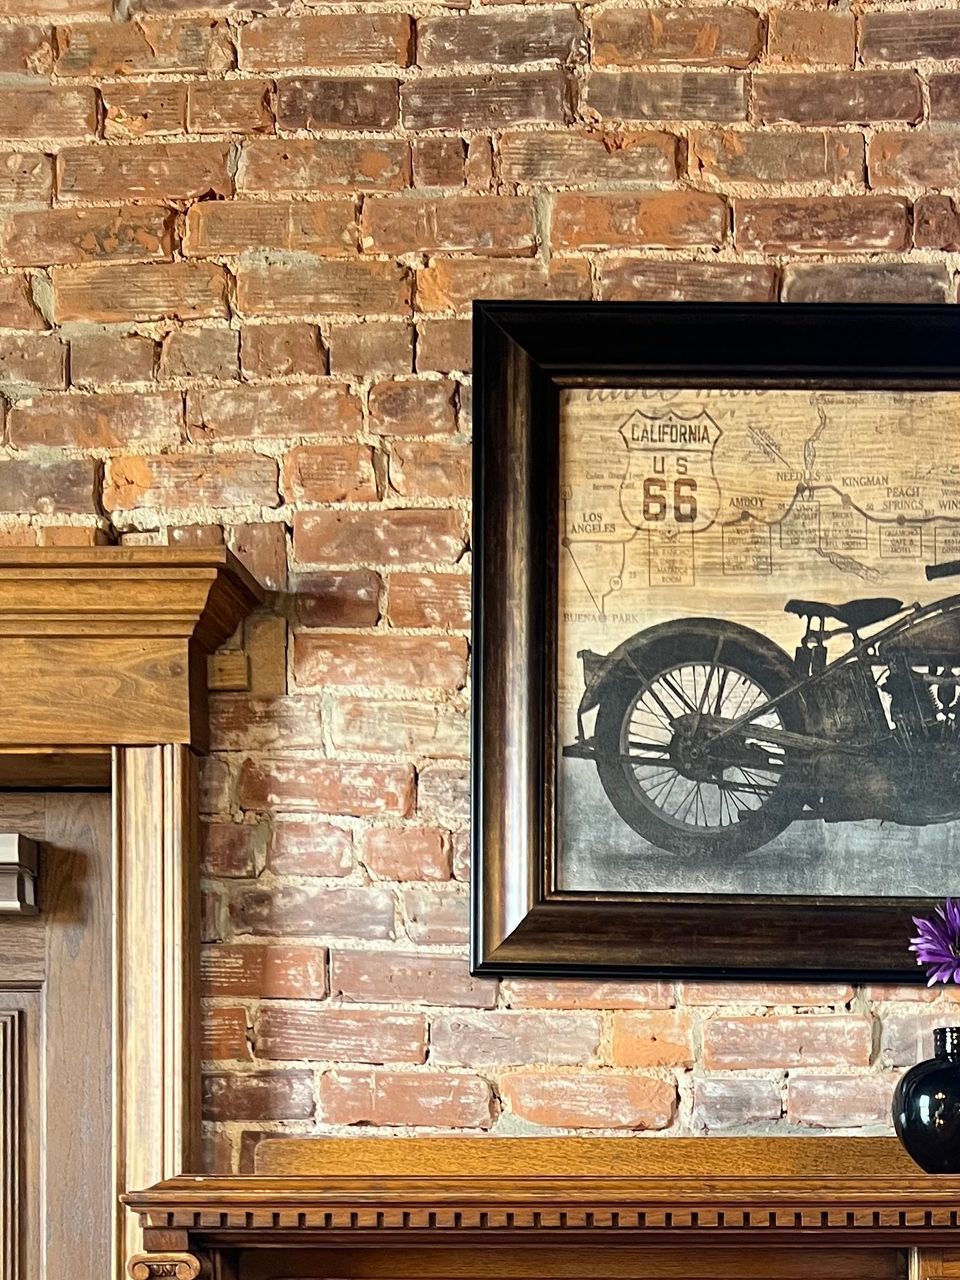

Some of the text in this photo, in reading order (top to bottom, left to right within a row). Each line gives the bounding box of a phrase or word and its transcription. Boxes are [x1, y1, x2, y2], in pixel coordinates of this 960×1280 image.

[631, 423, 711, 443] CALIFORNIA
[653, 456, 688, 475] U S
[776, 472, 821, 481] NEEDLES
[842, 476, 889, 487] KINGMAN
[886, 487, 920, 497] PEACH
[642, 477, 697, 523] 66
[729, 497, 765, 507] AMBOY
[882, 500, 924, 511] SPRINGS
[583, 512, 603, 522] LOS
[571, 524, 616, 534] ANGELES
[563, 613, 639, 623] BUENA PARK
